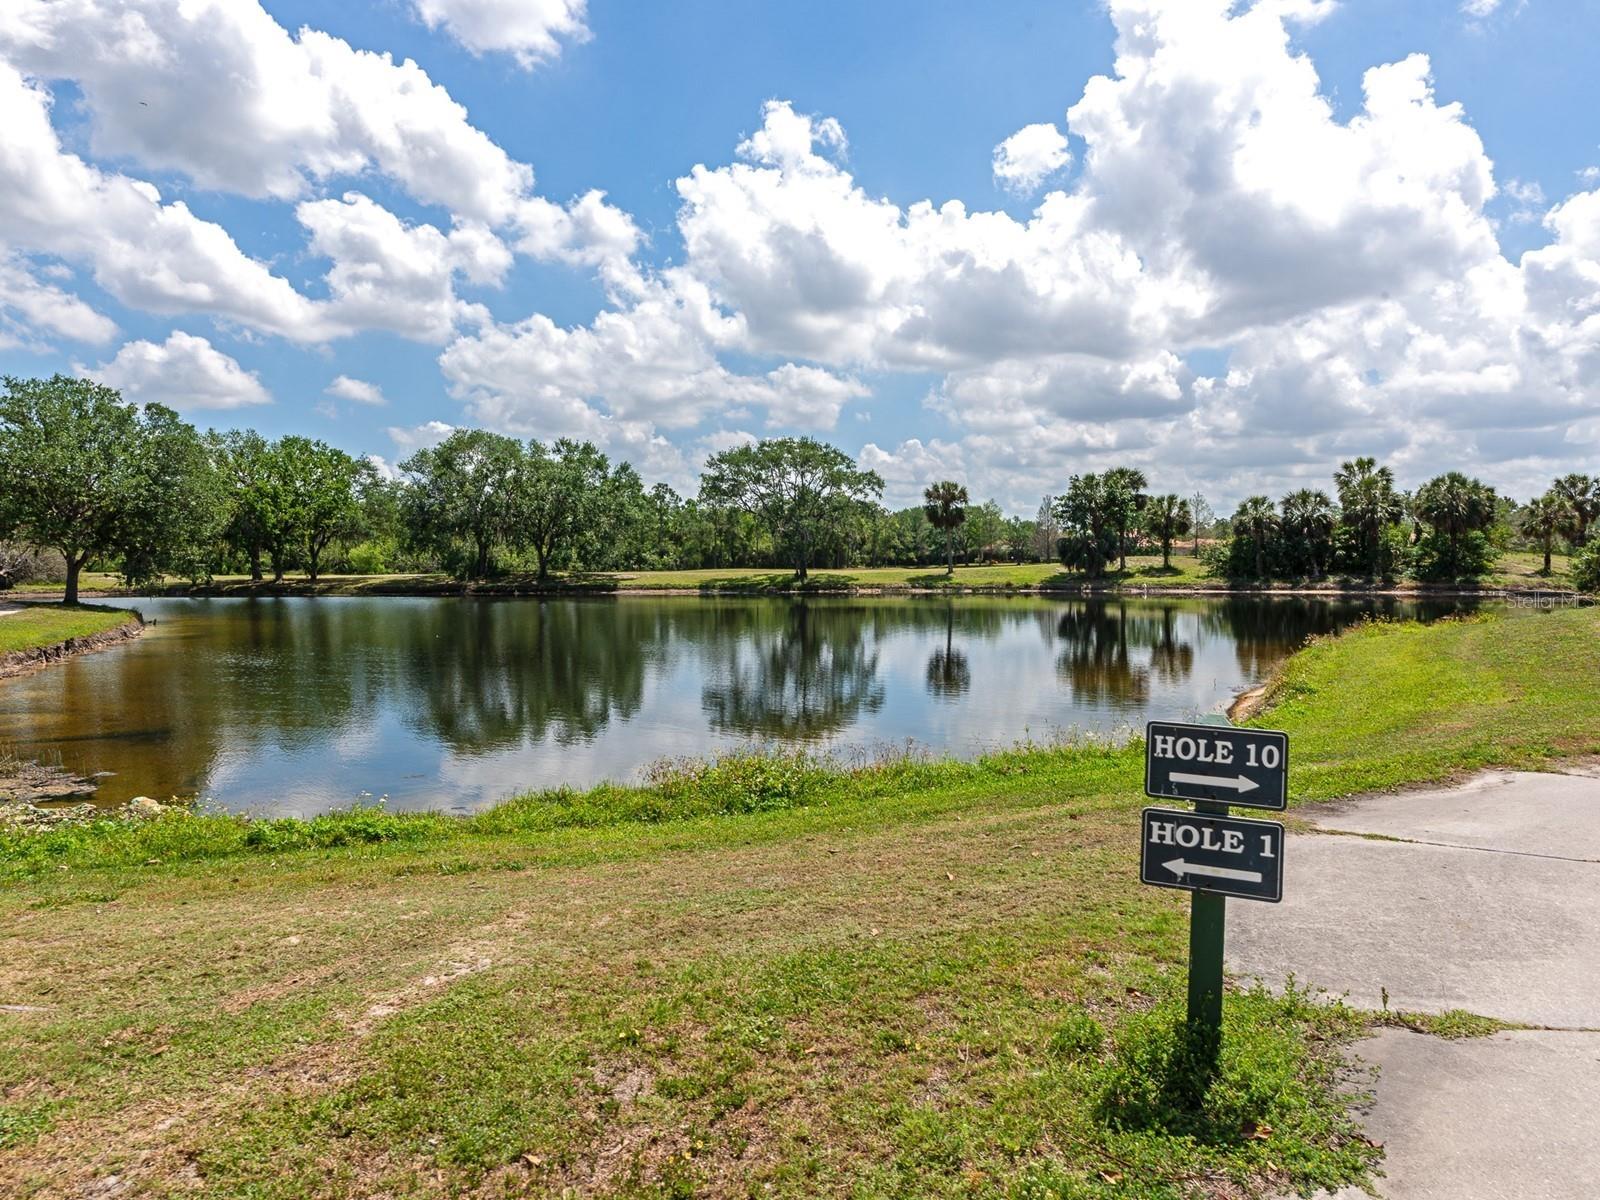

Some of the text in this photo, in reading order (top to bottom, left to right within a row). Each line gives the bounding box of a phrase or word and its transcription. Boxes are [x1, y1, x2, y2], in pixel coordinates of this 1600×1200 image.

[1154, 735, 1280, 768] HOLE 10
[1149, 821, 1275, 858] HOLE 1
